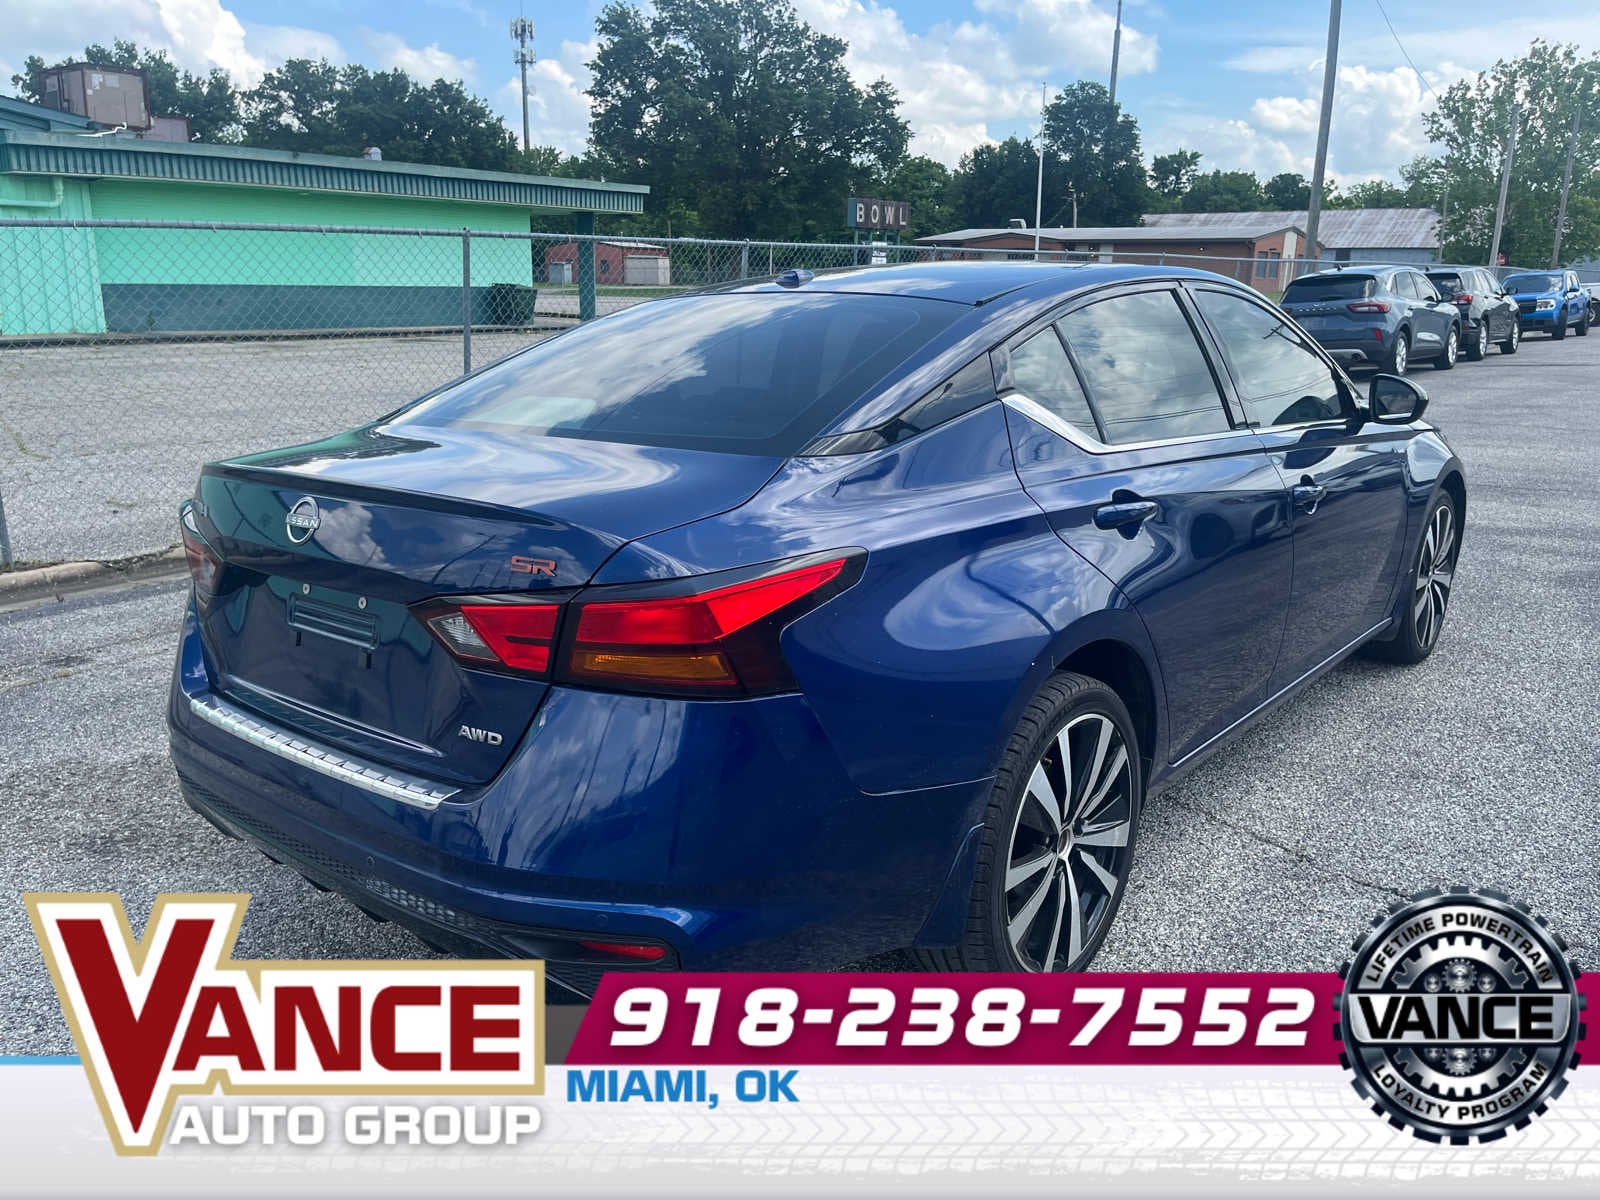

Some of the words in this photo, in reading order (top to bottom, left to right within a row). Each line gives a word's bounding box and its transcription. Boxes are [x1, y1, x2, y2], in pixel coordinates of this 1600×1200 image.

[856, 202, 907, 226] BOWL
[511, 555, 557, 577] SR
[458, 724, 503, 746] AWD
